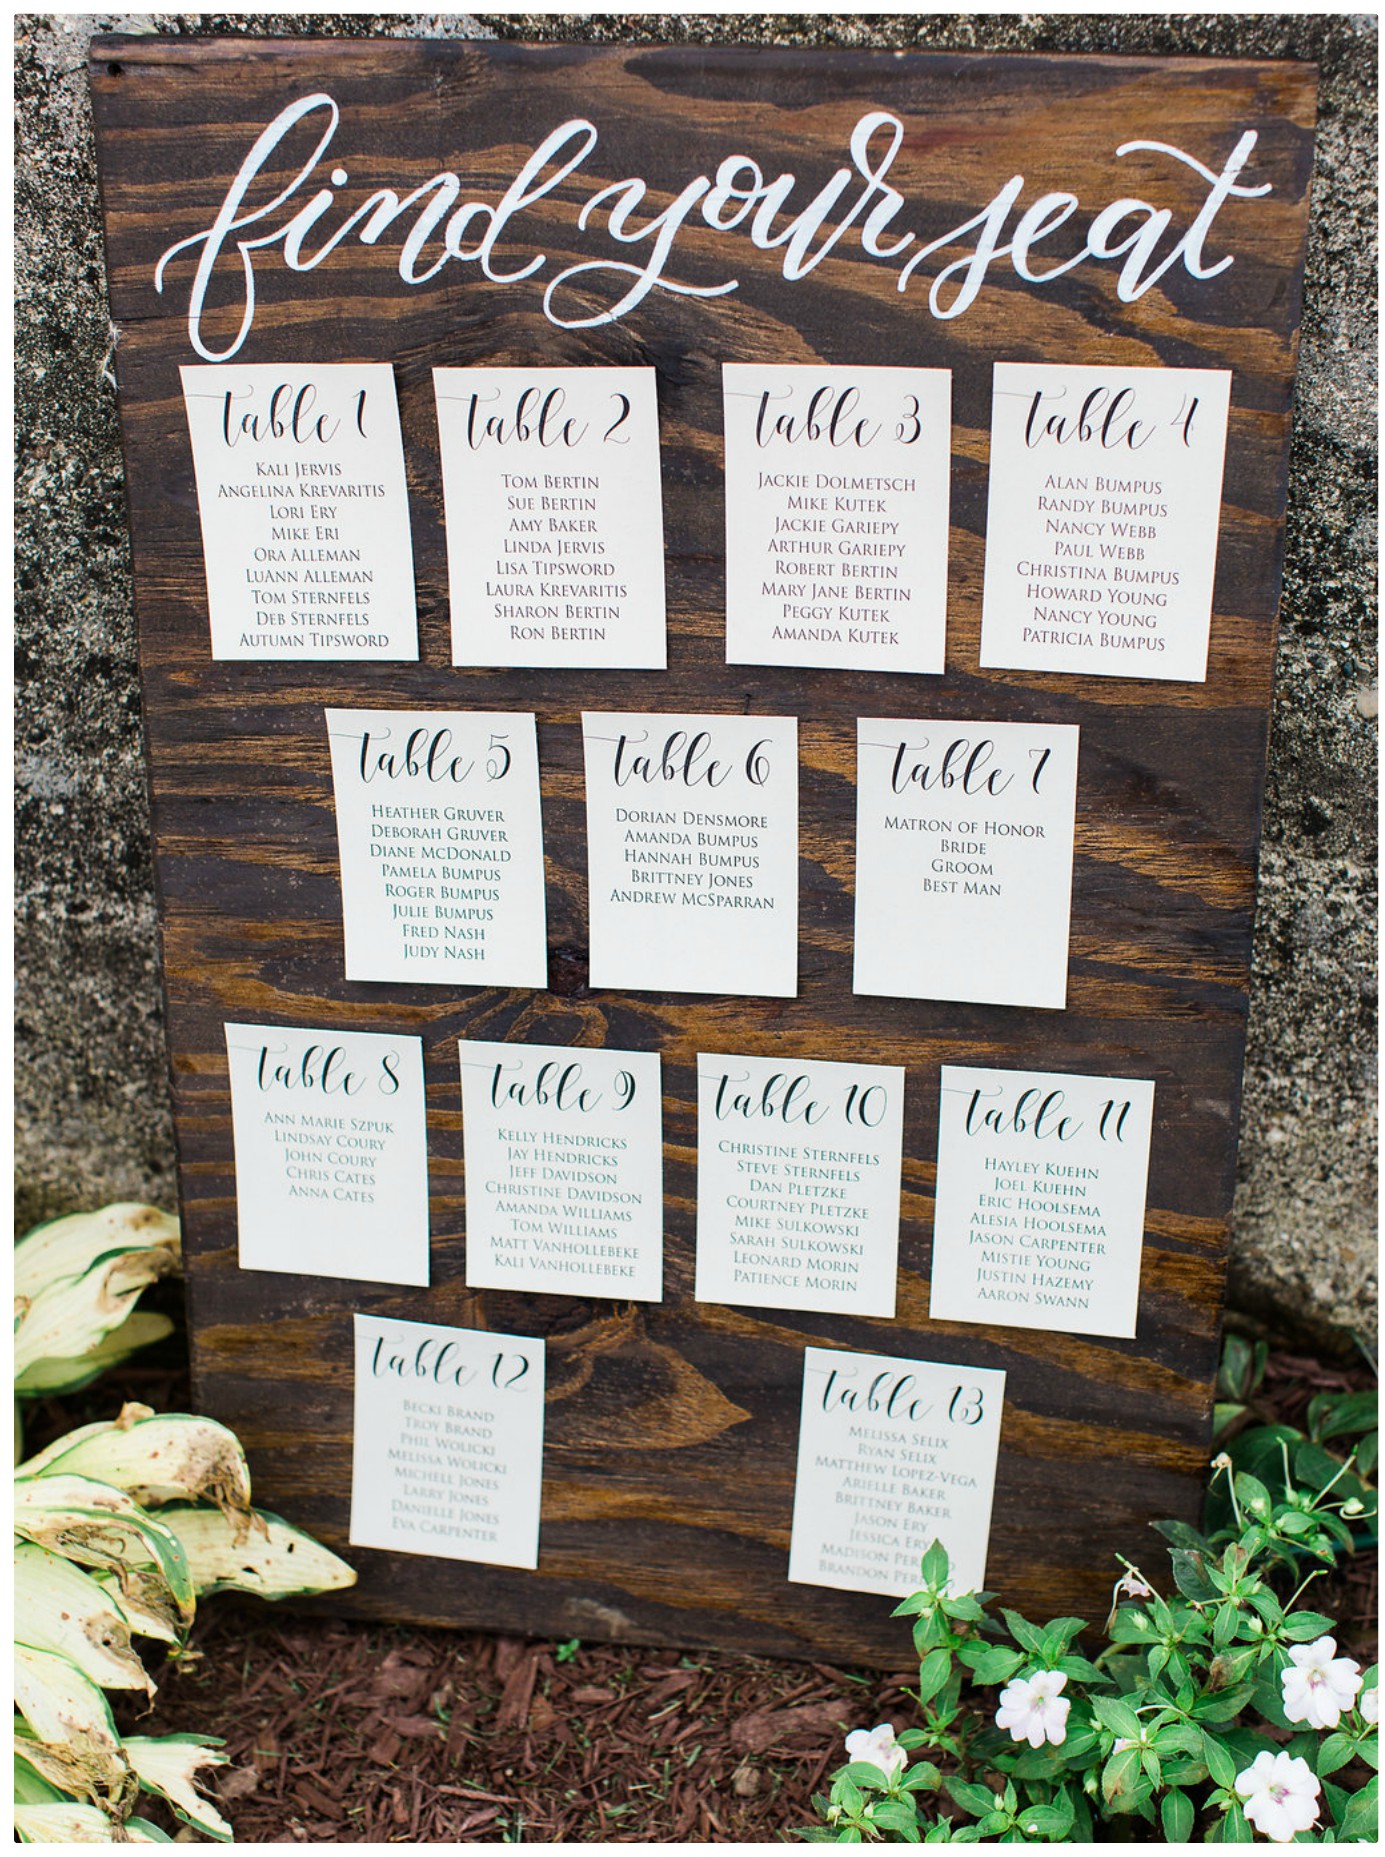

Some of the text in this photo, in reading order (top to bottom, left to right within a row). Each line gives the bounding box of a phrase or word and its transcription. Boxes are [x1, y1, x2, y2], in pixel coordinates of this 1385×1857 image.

[155, 93, 1273, 362] find your seat
[184, 384, 368, 448] table 1
[437, 387, 631, 450] table 2
[726, 385, 921, 448] table 3
[995, 384, 1199, 450] table 4
[255, 461, 342, 479] KALI JERVIS
[217, 482, 386, 498] ANGELINA KREVARITIS
[500, 473, 600, 490] TOM BERTIN
[758, 471, 916, 492] JACKIE DOLMETSCH
[1044, 474, 1162, 495] ALAN BUMPUS
[269, 504, 338, 520] LORI ERY
[507, 495, 596, 511] SUE BERTIN
[787, 495, 887, 513] MIKE KUTEK
[1037, 495, 1168, 518] RANDY BUMPUS
[271, 525, 339, 541] MIKE ERI
[508, 517, 598, 533] AMY BAKER
[774, 516, 900, 535] JACKIE GARIEPY
[1045, 518, 1157, 539] NANCY WEBB
[253, 547, 361, 562] ORA ALLEMAN
[503, 538, 605, 557] LINDA JERVIS
[767, 538, 906, 558] ARTHUR GARIEPY
[1055, 540, 1145, 561] PAUL WEBB
[246, 568, 374, 583] LUANN ALLEMAN
[496, 560, 616, 576] LISA TIPSWORD
[775, 559, 898, 579] ROBERT BERTIN
[1016, 560, 1180, 586] CHRISTINA BUMPUS
[250, 589, 371, 605] TOM STERNFELS
[486, 581, 628, 598] LAURA KREVARITIS
[761, 581, 911, 602] MARY JANE BERTIN
[1027, 583, 1167, 607] HOWARD YOUNG
[330, 727, 512, 783] table 5
[584, 730, 773, 787] table 6
[859, 737, 1051, 795] table 7
[371, 804, 505, 823] HEATHER GRUVER
[615, 808, 768, 829] DORIAN DENSMORE
[371, 823, 509, 843] DEBORAH GRUVER
[884, 815, 1046, 839] MATRON OF HONOR
[624, 829, 759, 849] AMANDA BUMPUS
[940, 838, 986, 856] BRIDE
[370, 843, 512, 863] DIANE MCDONALD
[624, 848, 760, 869] HANNAH BUMPUS
[382, 863, 501, 882] PAMELA BUMPUS
[931, 858, 993, 876] GROOM
[631, 869, 753, 890] BRITTNEY JONES
[923, 877, 1001, 896] BEST MAN
[385, 883, 500, 902] ROGER BUMPUS
[610, 888, 774, 910] ANDREW MCSPARRAN
[393, 903, 494, 921] JULIE BUMPUS
[229, 1042, 400, 1096] table 8
[461, 1059, 636, 1112] table 9
[698, 1071, 887, 1127] table 10
[943, 1085, 1131, 1142] table 11
[357, 1334, 529, 1392] table 12
[807, 1367, 984, 1425] table 13
